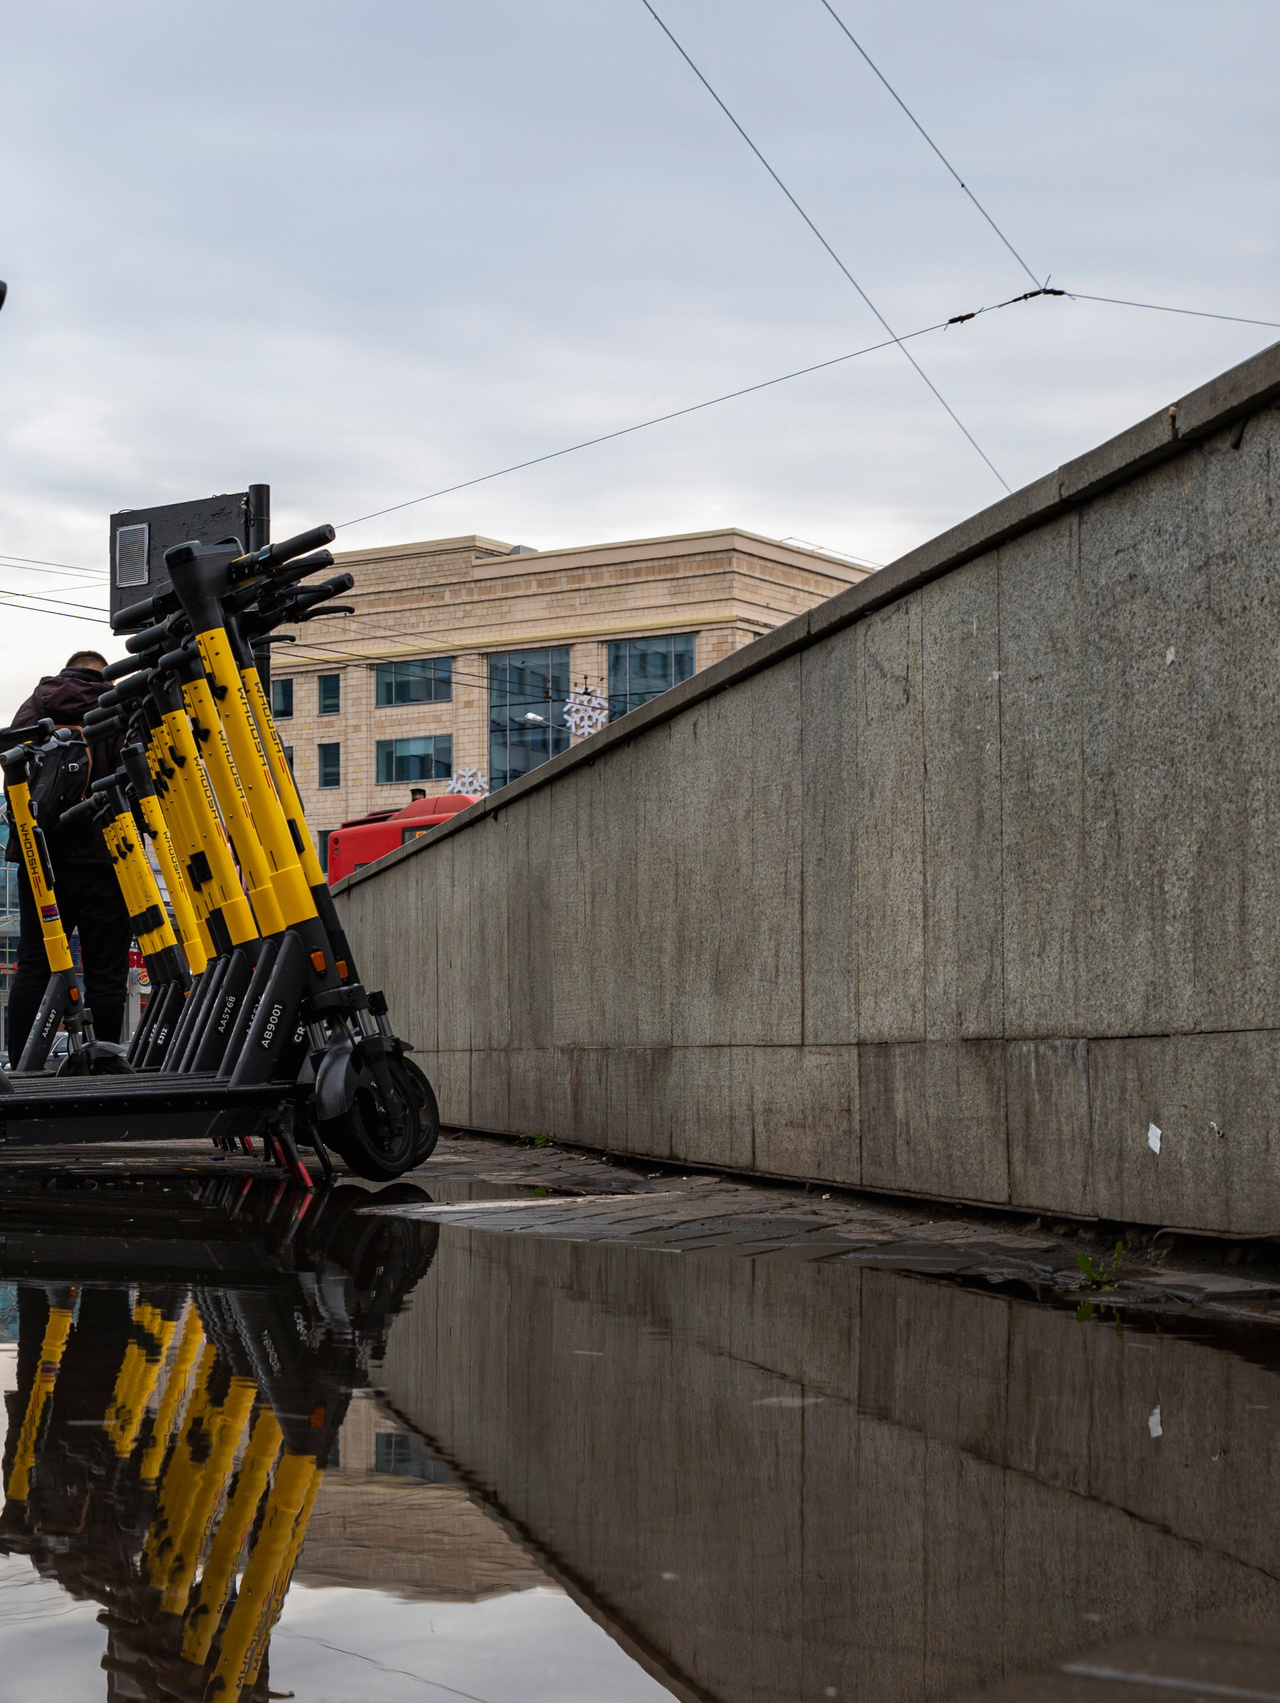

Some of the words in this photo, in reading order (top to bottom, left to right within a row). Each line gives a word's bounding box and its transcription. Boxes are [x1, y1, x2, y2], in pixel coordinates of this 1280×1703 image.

[237, 687, 267, 768] WHOOSH
[253, 681, 282, 754] WHOOSH
[193, 756, 219, 821] WHOOSH
[218, 729, 246, 800] WHOOSH
[19, 822, 39, 875] WHOOSH
[163, 830, 183, 881] WHOOSH
[218, 995, 236, 1034] AA5768
[261, 1003, 284, 1049] AB9001
